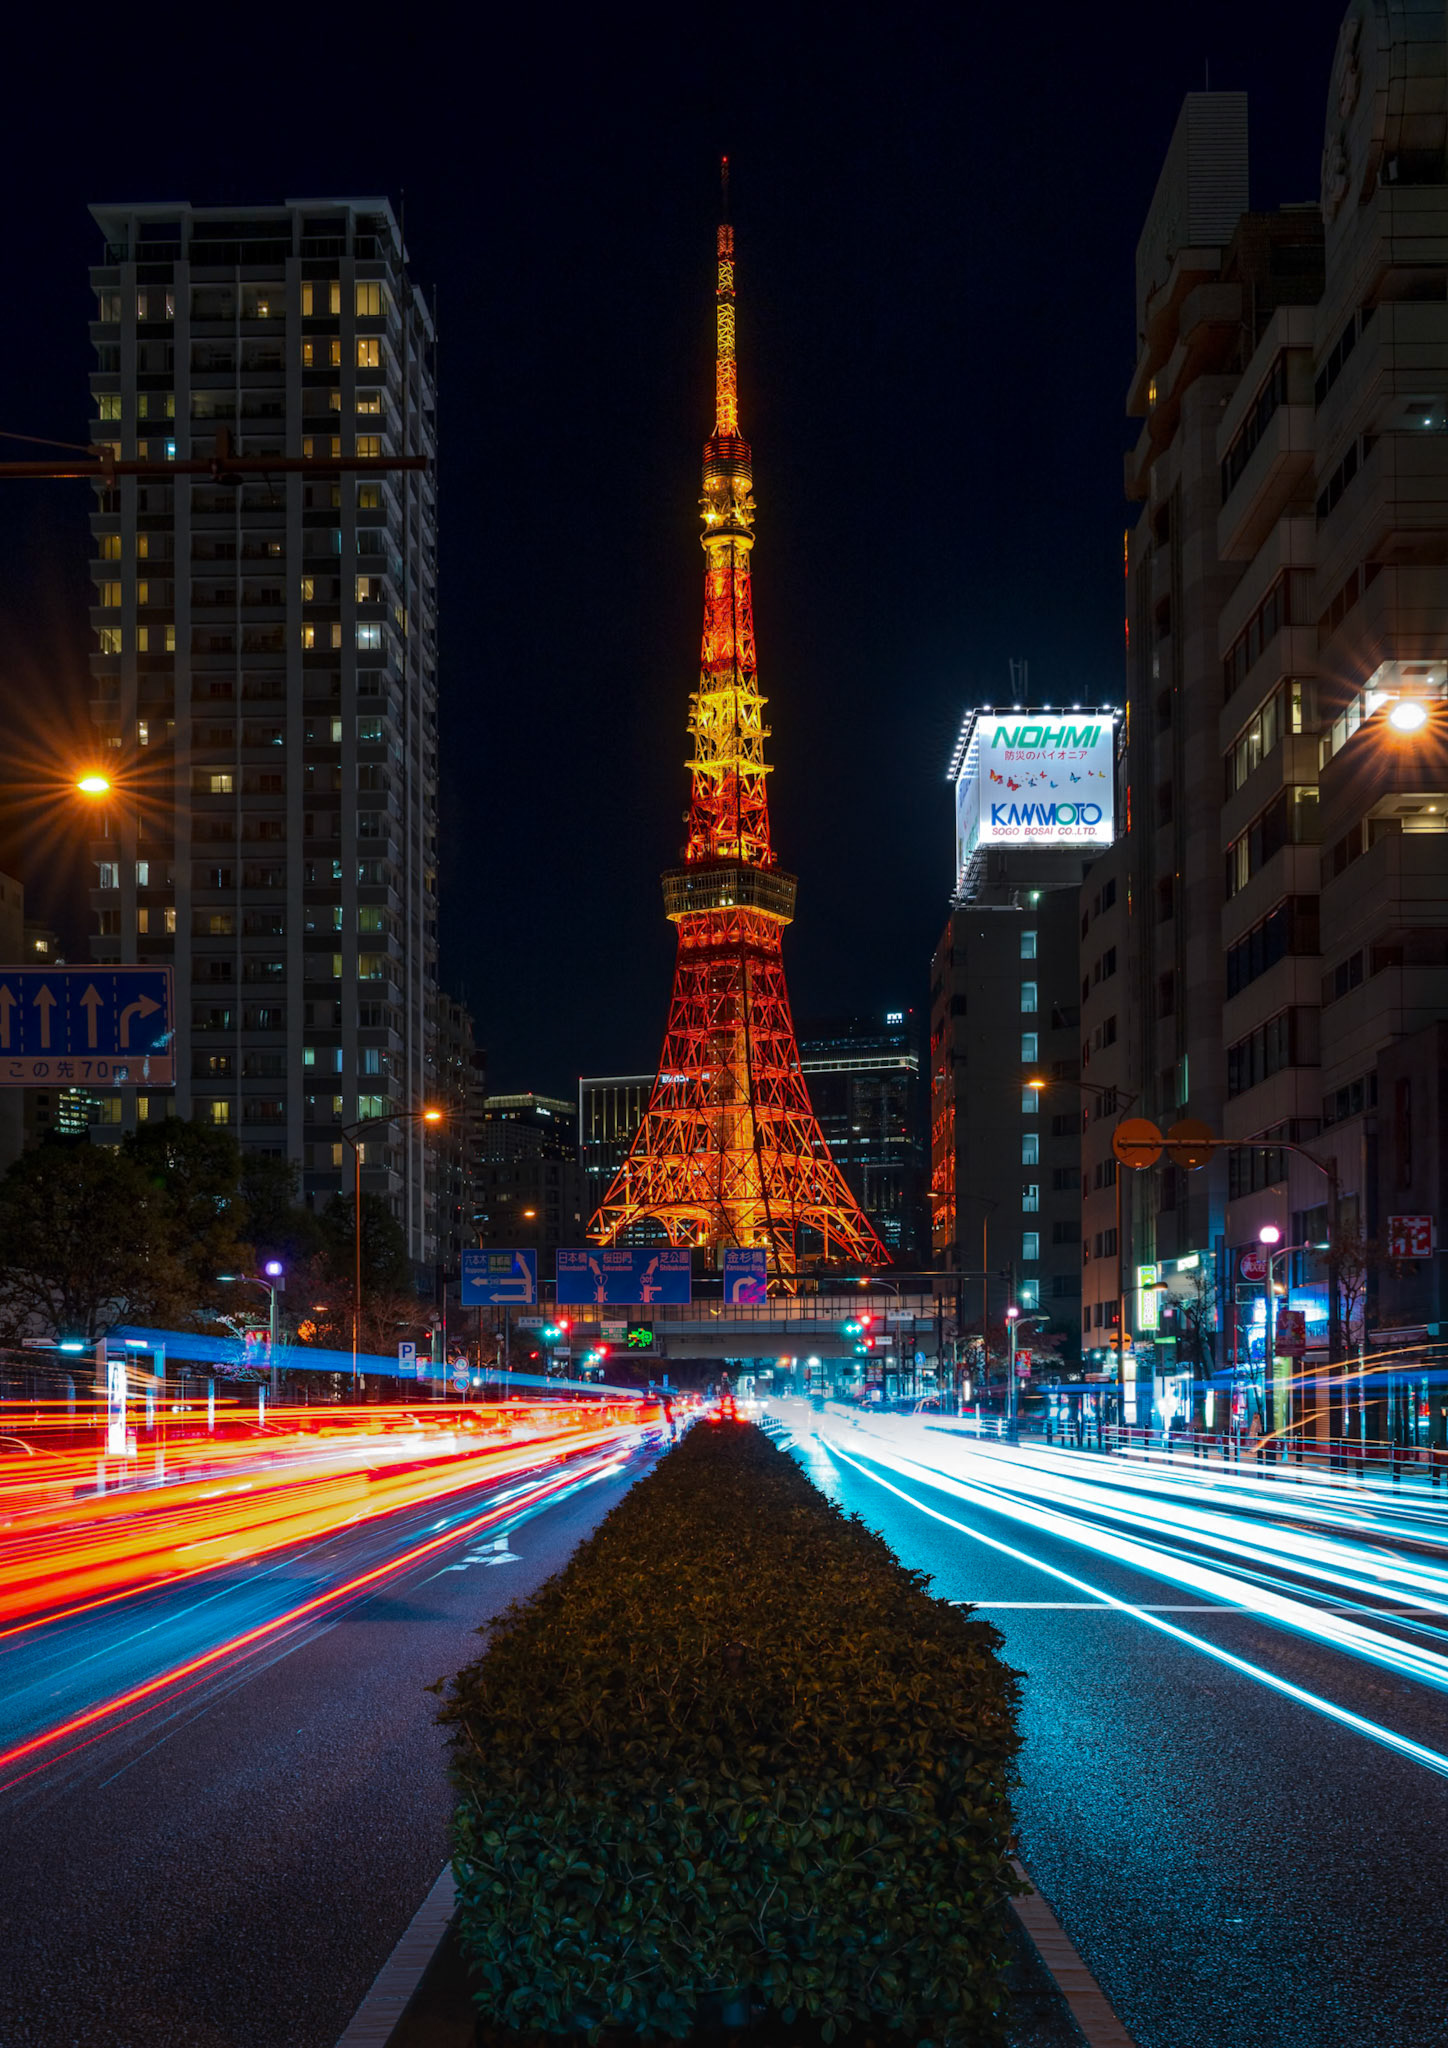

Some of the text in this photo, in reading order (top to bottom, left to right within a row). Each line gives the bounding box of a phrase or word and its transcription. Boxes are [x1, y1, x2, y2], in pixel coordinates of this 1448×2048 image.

[991, 725, 1102, 749] NOHMI
[1004, 750, 1088, 761] 防災のパイオニア
[991, 802, 1102, 826] KAWAMOTO
[992, 827, 1020, 836] SOGO
[1024, 827, 1053, 836] BOSAI
[464, 1255, 487, 1266] 六本木
[558, 1252, 587, 1264] 日本橋
[602, 1251, 633, 1264] 桜田門
[659, 1251, 689, 1264] 芝公園
[727, 1251, 764, 1264] 金杉橋
[402, 1344, 413, 1358] P
